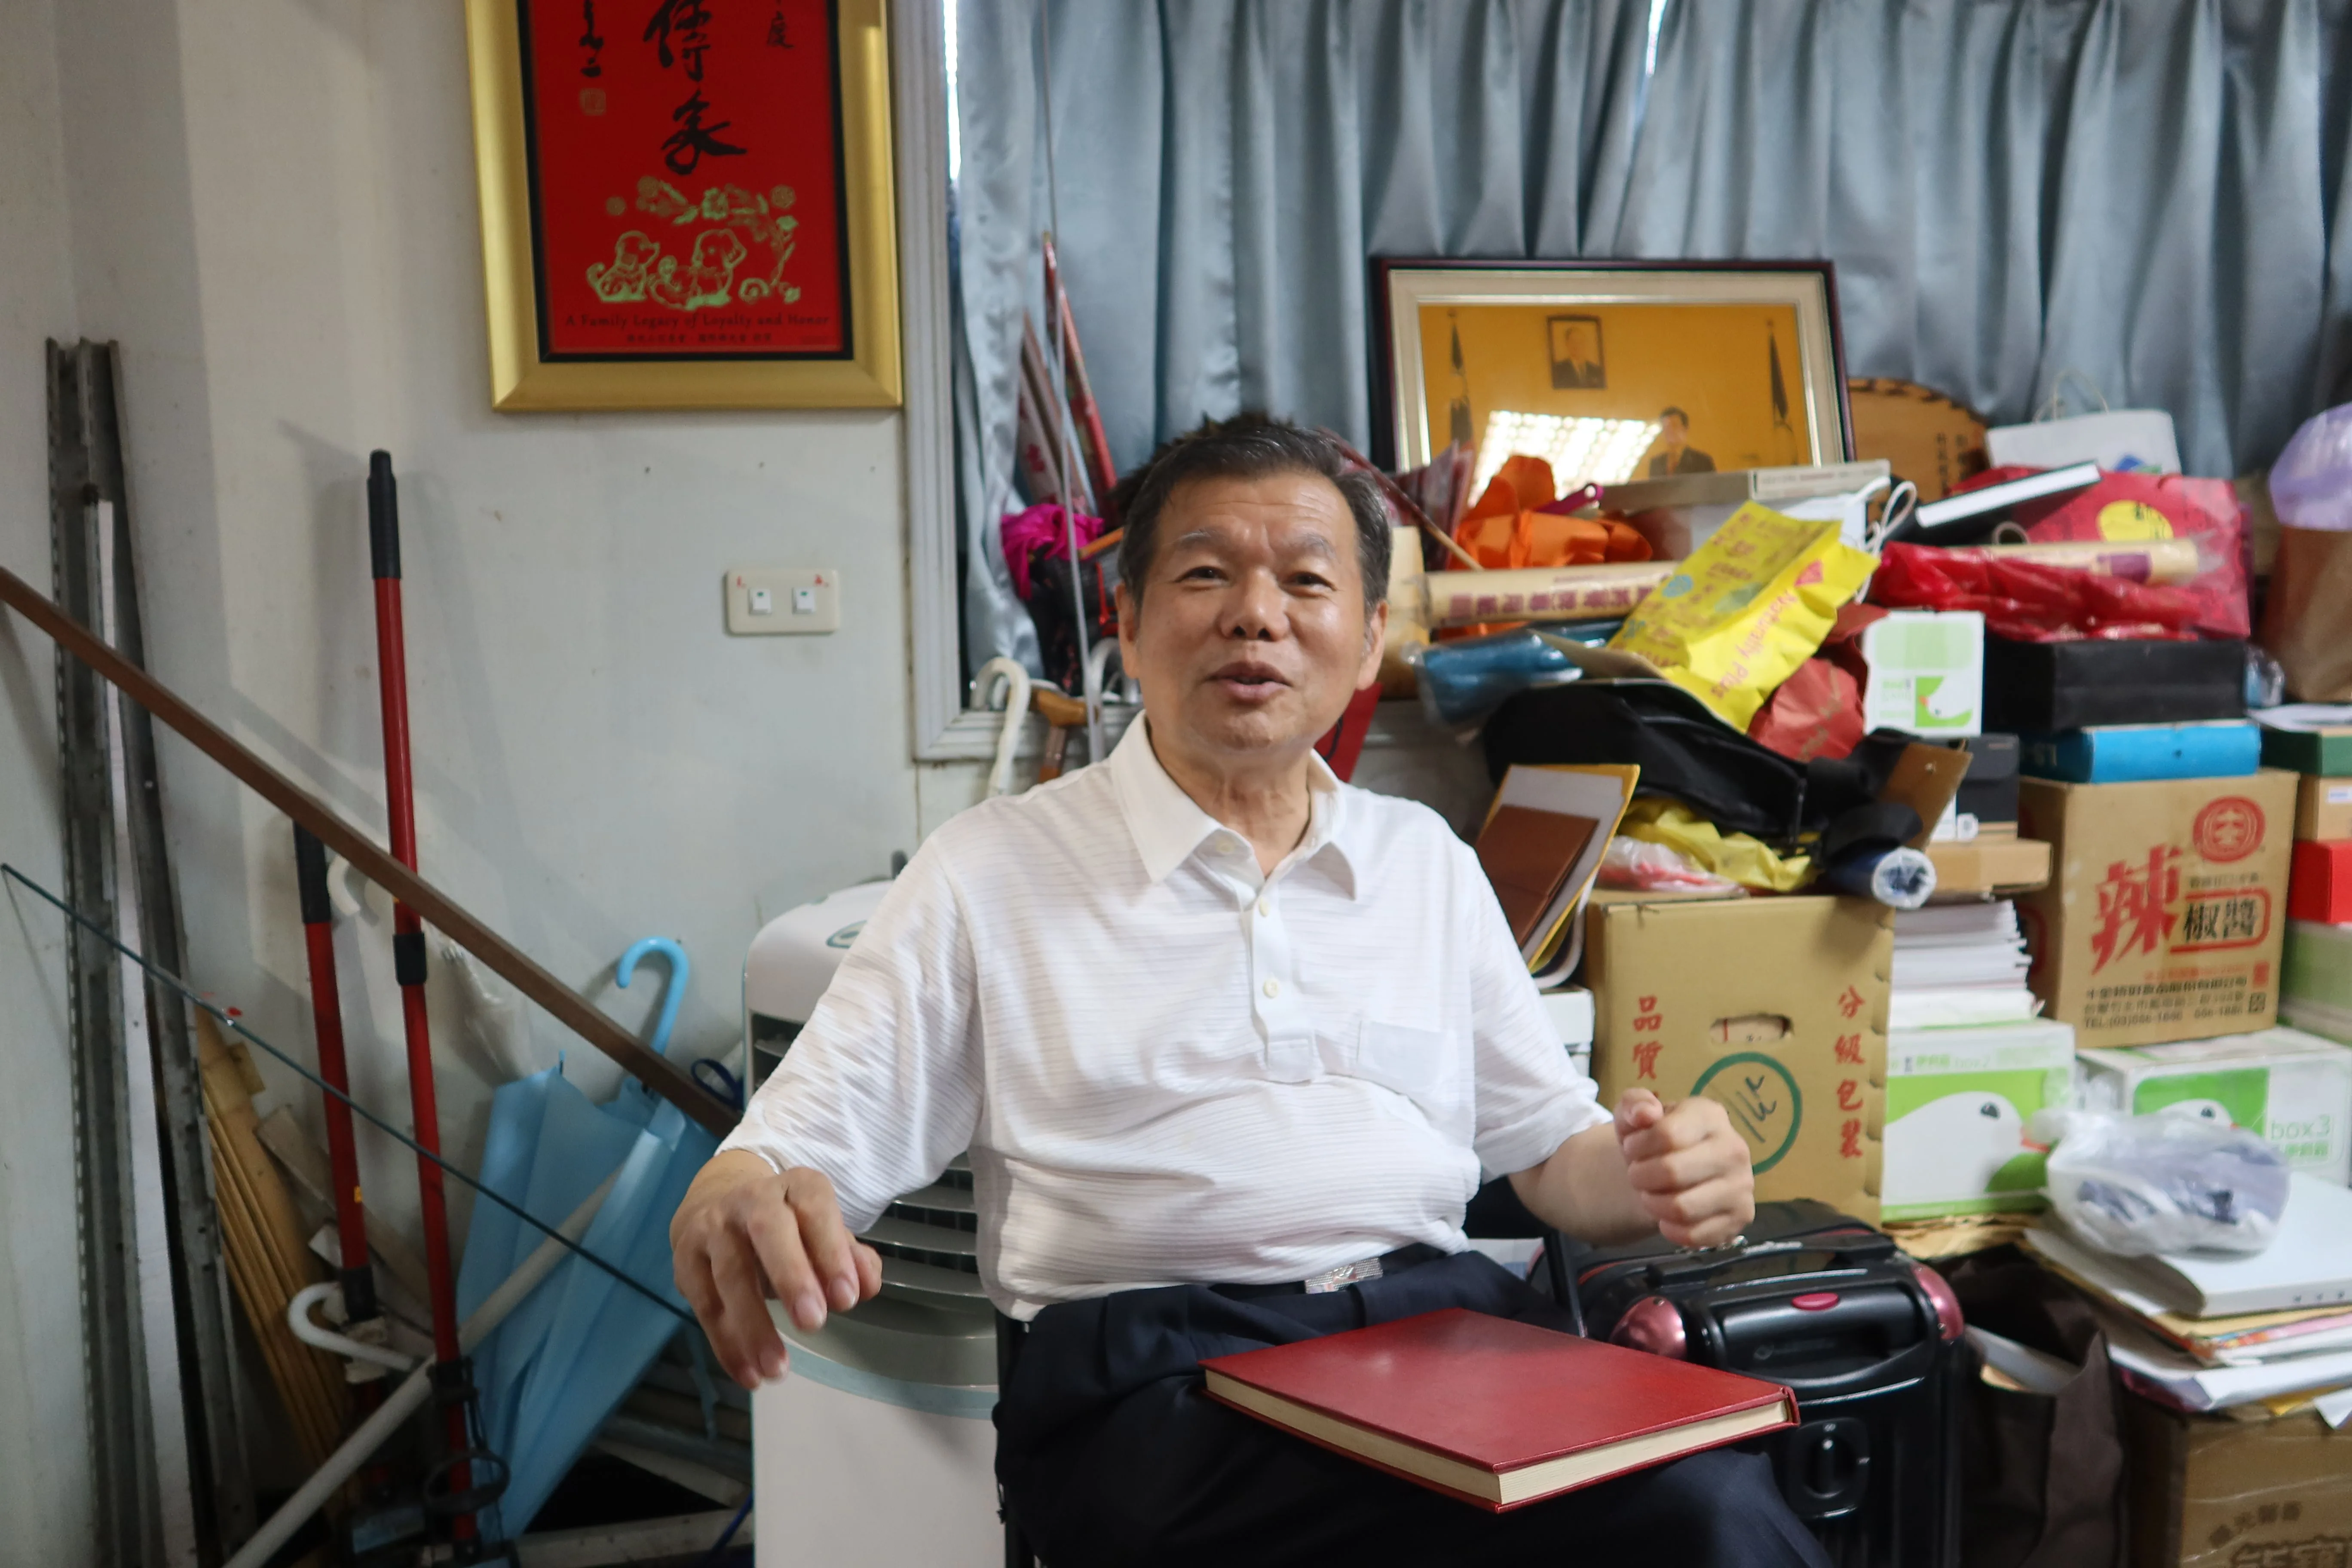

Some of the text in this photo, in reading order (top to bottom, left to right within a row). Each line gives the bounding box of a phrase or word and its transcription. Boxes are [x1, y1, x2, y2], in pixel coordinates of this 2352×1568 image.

[565, 313, 830, 329] A Family Legacy of Loyalty and Honor
[1632, 994, 1664, 1097] 品質
[2272, 1114, 2331, 1140] box3
